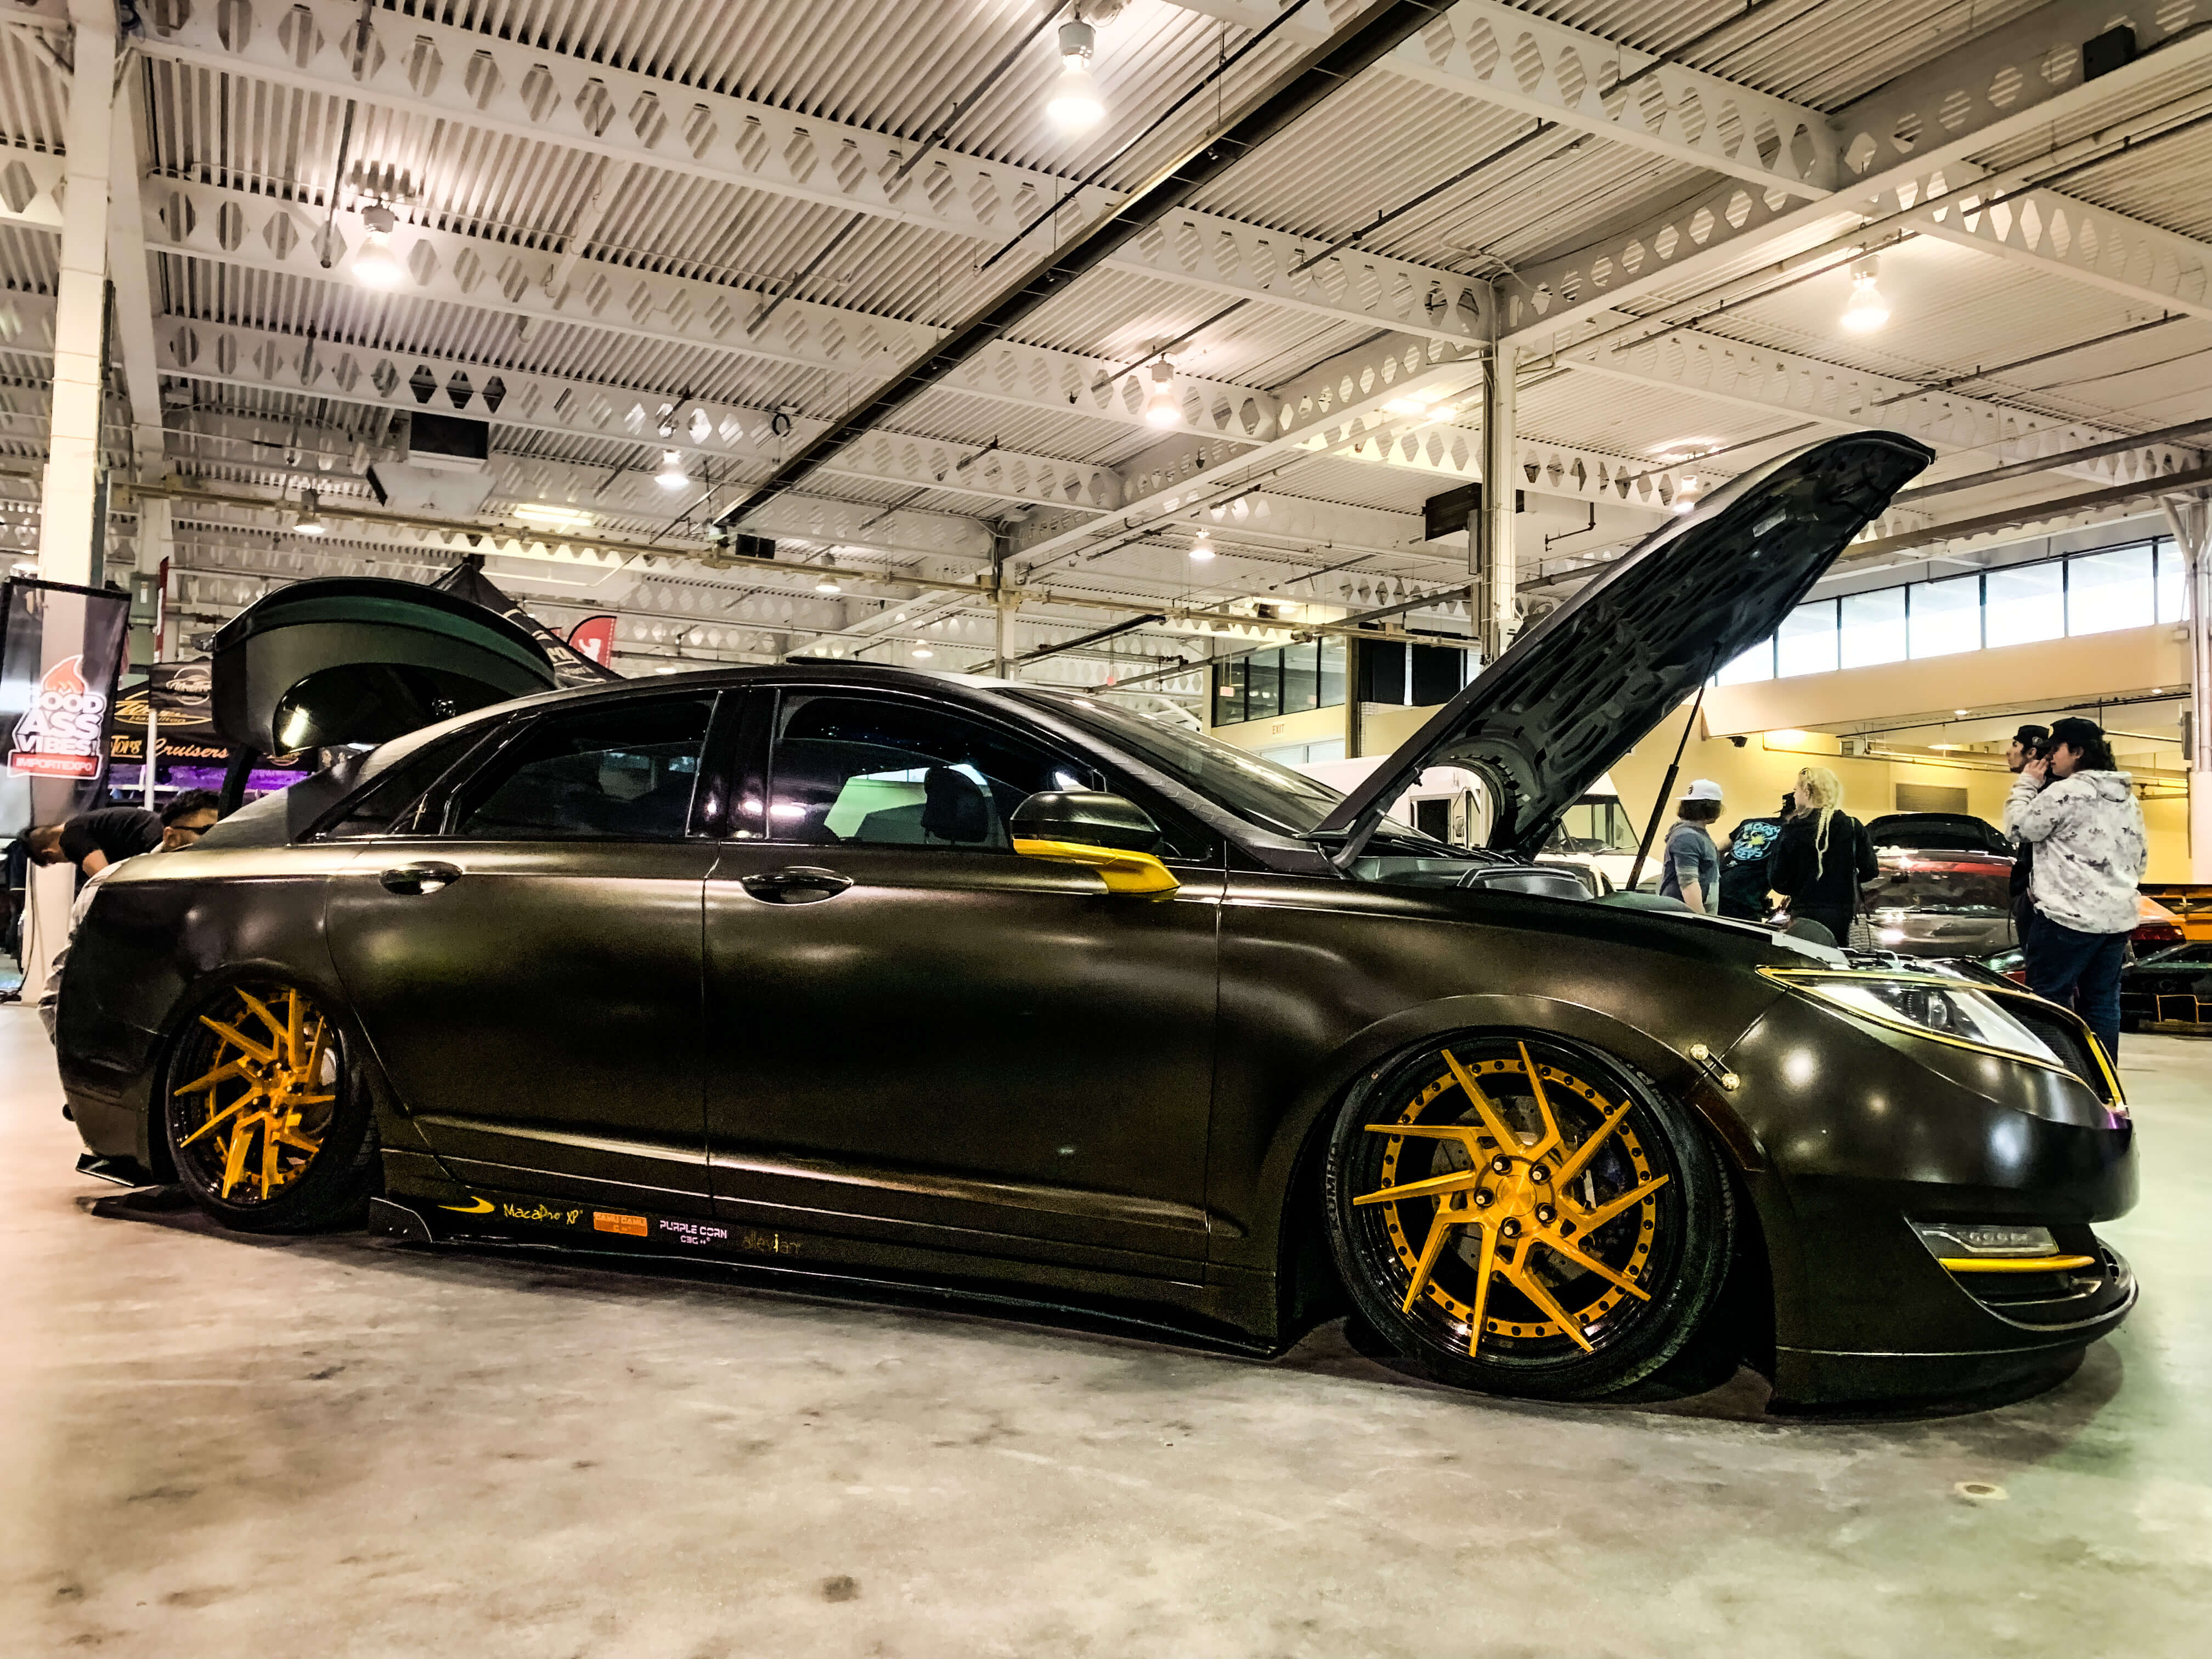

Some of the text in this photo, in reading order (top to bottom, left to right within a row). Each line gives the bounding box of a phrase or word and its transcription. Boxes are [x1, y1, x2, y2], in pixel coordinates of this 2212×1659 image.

[27, 690, 105, 714] OOD
[17, 708, 101, 740] ASS
[1272, 723, 1285, 735] EXIT
[17, 735, 98, 756] VIBES!
[154, 737, 229, 759] Cruisers
[659, 1220, 727, 1239] PURPLE CORN
